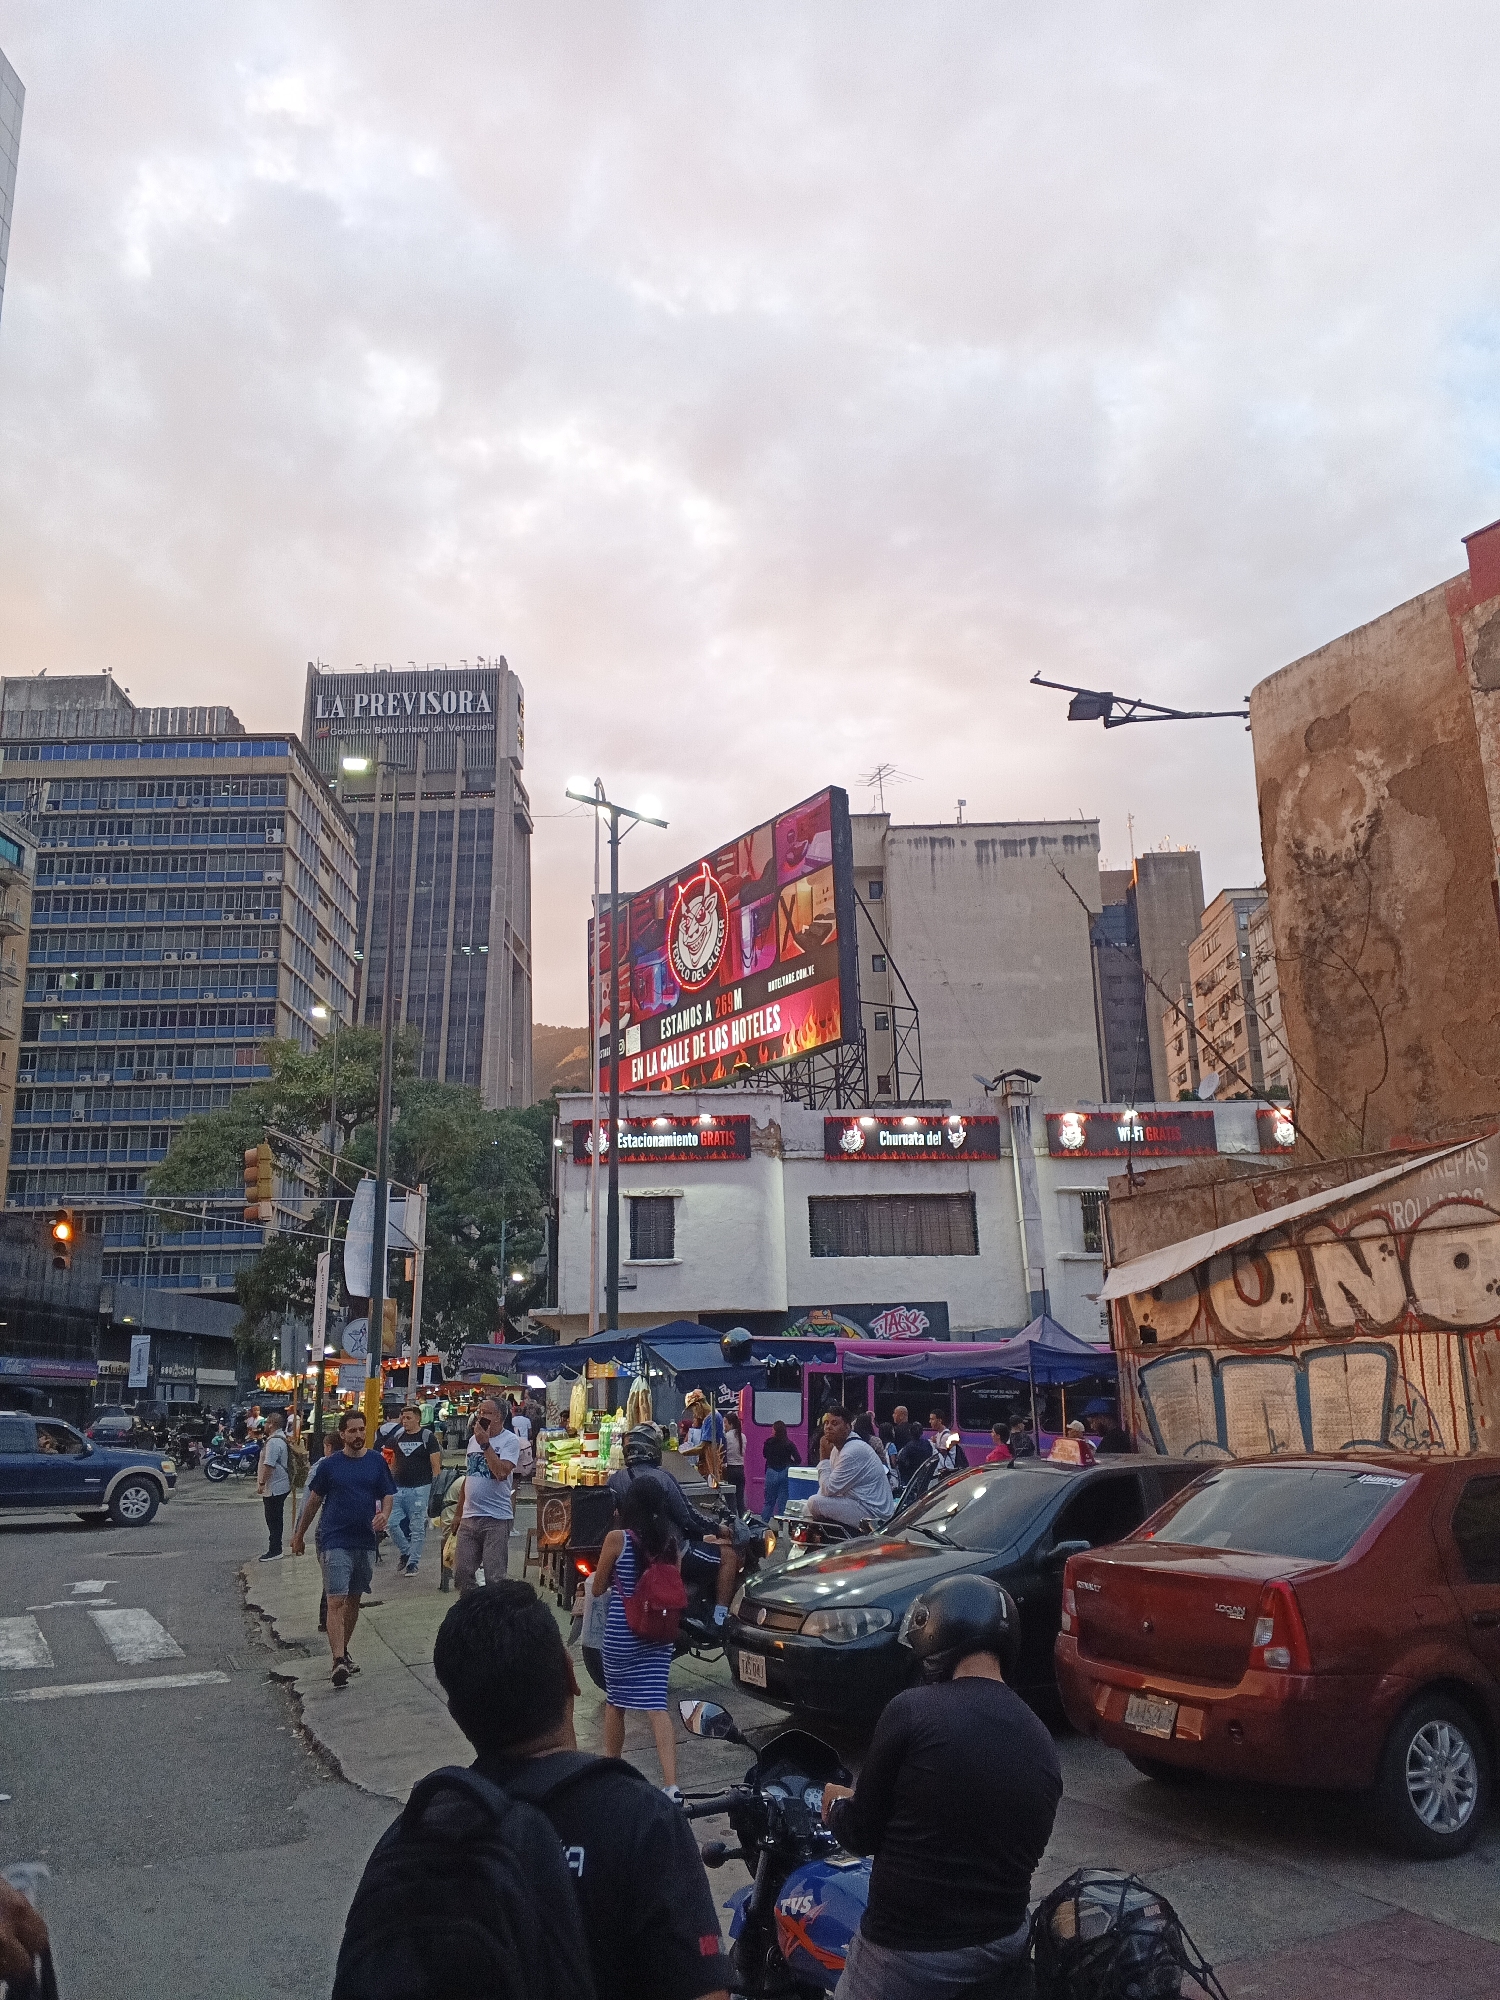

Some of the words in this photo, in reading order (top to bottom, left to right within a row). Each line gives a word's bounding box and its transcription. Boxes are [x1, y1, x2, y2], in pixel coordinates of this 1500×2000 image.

[315, 694, 346, 719] LA
[353, 689, 492, 718] PREVISORA
[330, 727, 371, 736] Gobierno
[374, 726, 429, 735] Bolivariano
[433, 724, 444, 733] de
[449, 723, 495, 732] Venezuela
[672, 940, 691, 981] TEMPLO
[691, 968, 707, 982] DEL
[706, 918, 726, 971] PLACER
[660, 1004, 703, 1040] ESTAMOS
[705, 1000, 713, 1022] A
[715, 987, 743, 1018] 269M
[631, 1055, 644, 1082] EN
[646, 1051, 658, 1077] LA
[660, 1038, 690, 1073] CALLE
[693, 1032, 706, 1058] DE
[709, 1024, 728, 1055] LOS
[731, 1003, 781, 1046] HOTELES
[617, 1131, 699, 1149] Estacionamiento
[700, 1130, 736, 1146] GRATIS
[926, 1130, 942, 1146] del
[1117, 1126, 1144, 1142] Wi-Fi
[1145, 1126, 1181, 1141] GRATIS
[1215, 1603, 1245, 1616] LOGAN
[780, 1895, 814, 1916] TVS
